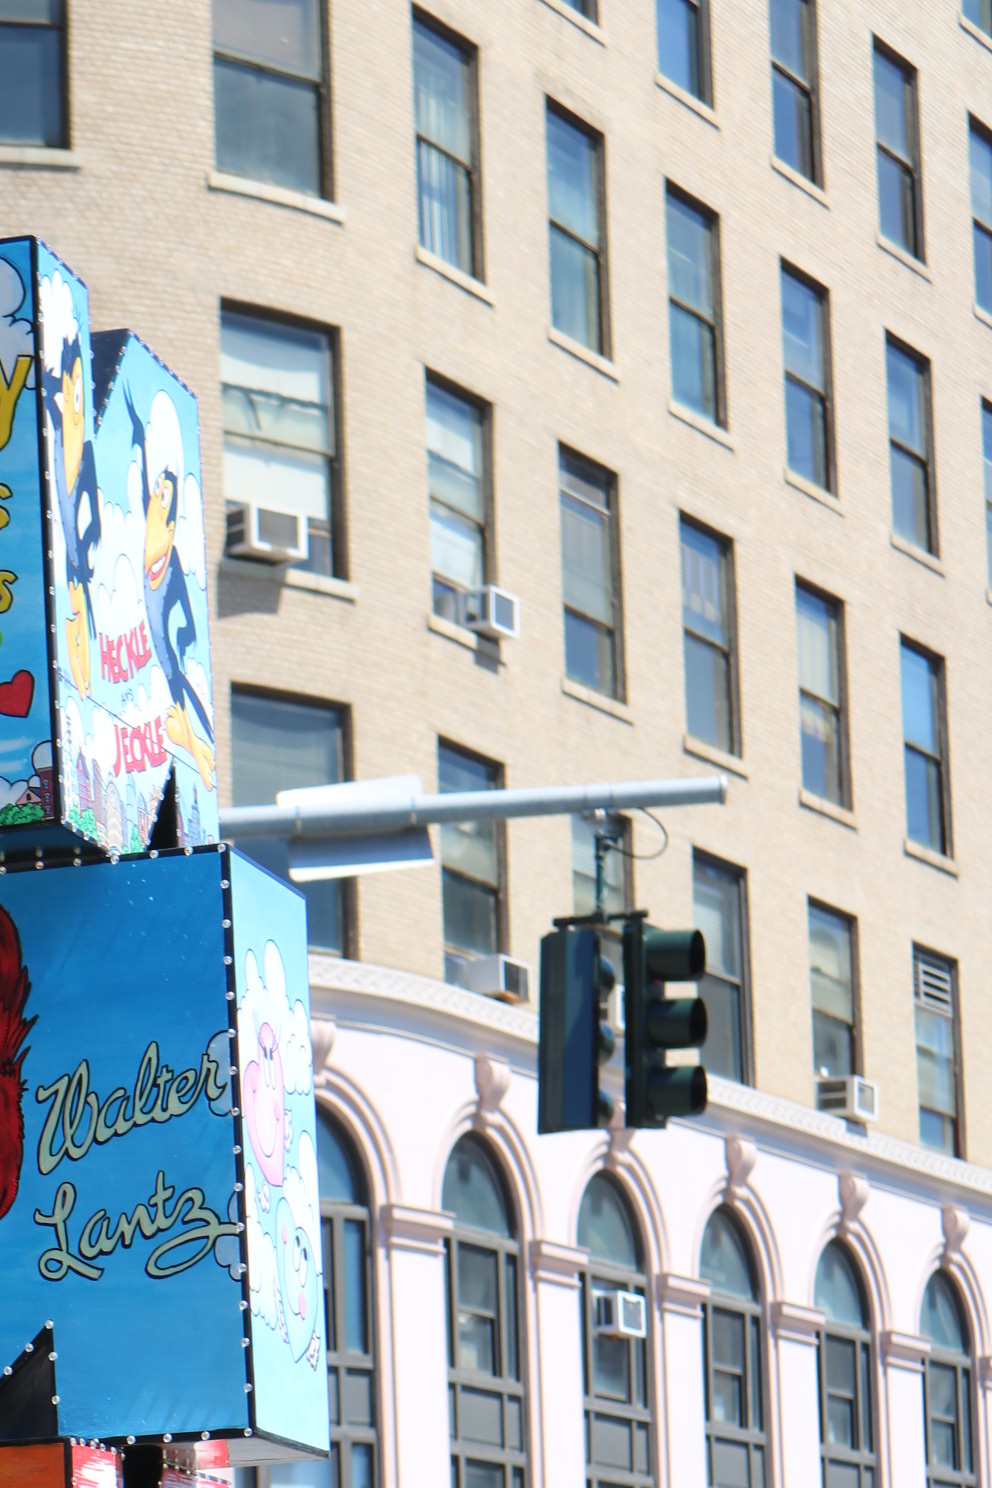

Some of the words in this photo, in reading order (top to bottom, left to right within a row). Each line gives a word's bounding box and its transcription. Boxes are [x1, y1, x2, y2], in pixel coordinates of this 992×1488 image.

[98, 619, 152, 684] HECKLE
[113, 715, 168, 778] JECKLE
[36, 1041, 227, 1175] Walter
[34, 1170, 240, 1281] Lantz
